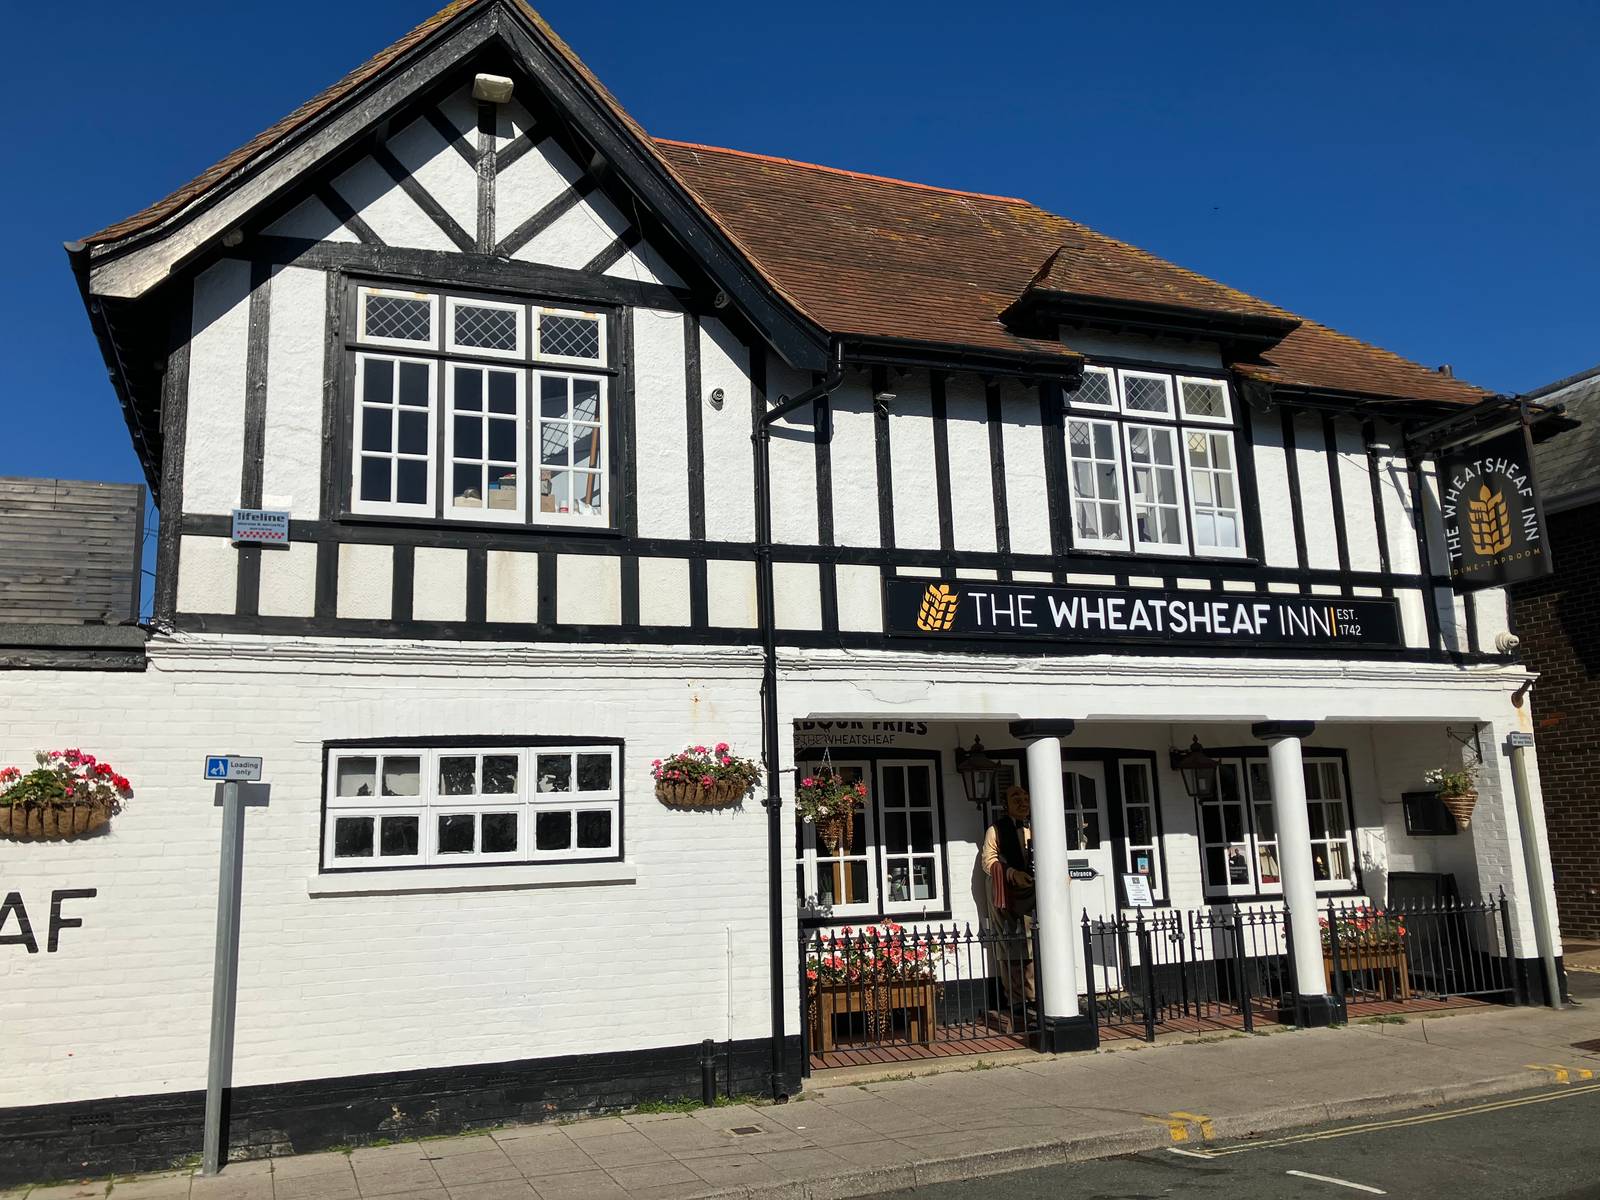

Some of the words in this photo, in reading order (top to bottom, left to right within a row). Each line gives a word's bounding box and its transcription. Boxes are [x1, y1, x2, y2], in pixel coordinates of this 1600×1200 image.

[1443, 457, 1533, 518] WHEATSHEAF
[237, 512, 285, 522] lifeline
[1521, 507, 1540, 541] INN
[1446, 525, 1463, 562] THE
[967, 592, 1038, 628] THE
[1047, 596, 1271, 635] WHEATSHEAF
[1279, 605, 1331, 636] INN
[1336, 608, 1358, 620] EST.
[1338, 624, 1362, 636] 1742
[824, 734, 896, 745] WHEATSHEAF
[0, 888, 97, 953] AF
